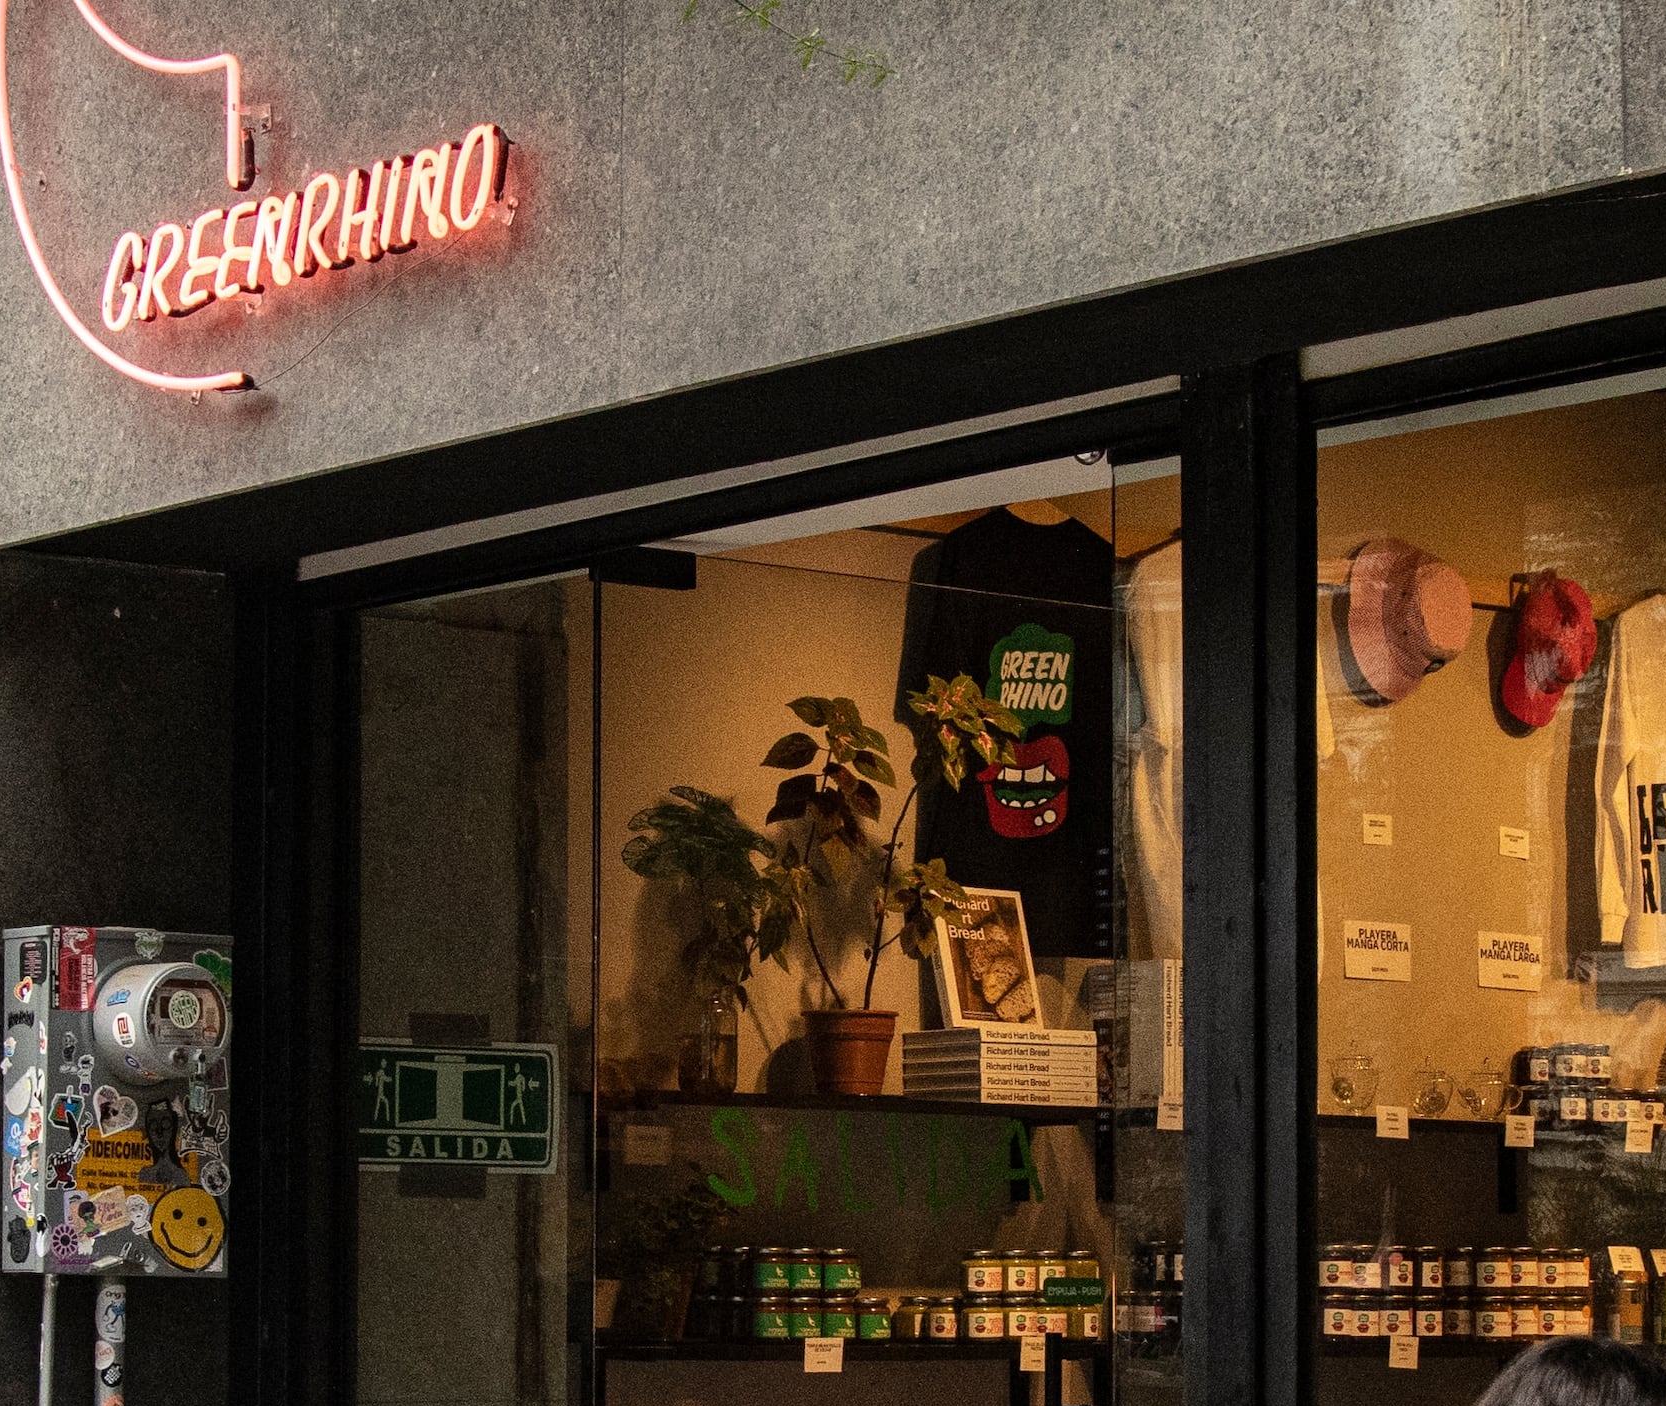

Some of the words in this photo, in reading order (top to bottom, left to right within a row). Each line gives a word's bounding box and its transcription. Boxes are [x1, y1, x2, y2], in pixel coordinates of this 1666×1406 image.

[1000, 650, 1071, 680] GREEN
[999, 681, 1068, 711] RHINO
[948, 925, 985, 941] Bread
[1358, 928, 1397, 940] PLAYERA
[1346, 937, 1379, 950] MANGA
[1381, 940, 1409, 953] CORTA
[1492, 939, 1530, 952] PLAYERA
[1480, 948, 1511, 961] MANGA
[1513, 951, 1540, 964] LARGA
[85, 1139, 153, 1160] FIDEICOMIS
[386, 1135, 514, 1159] SALIDA
